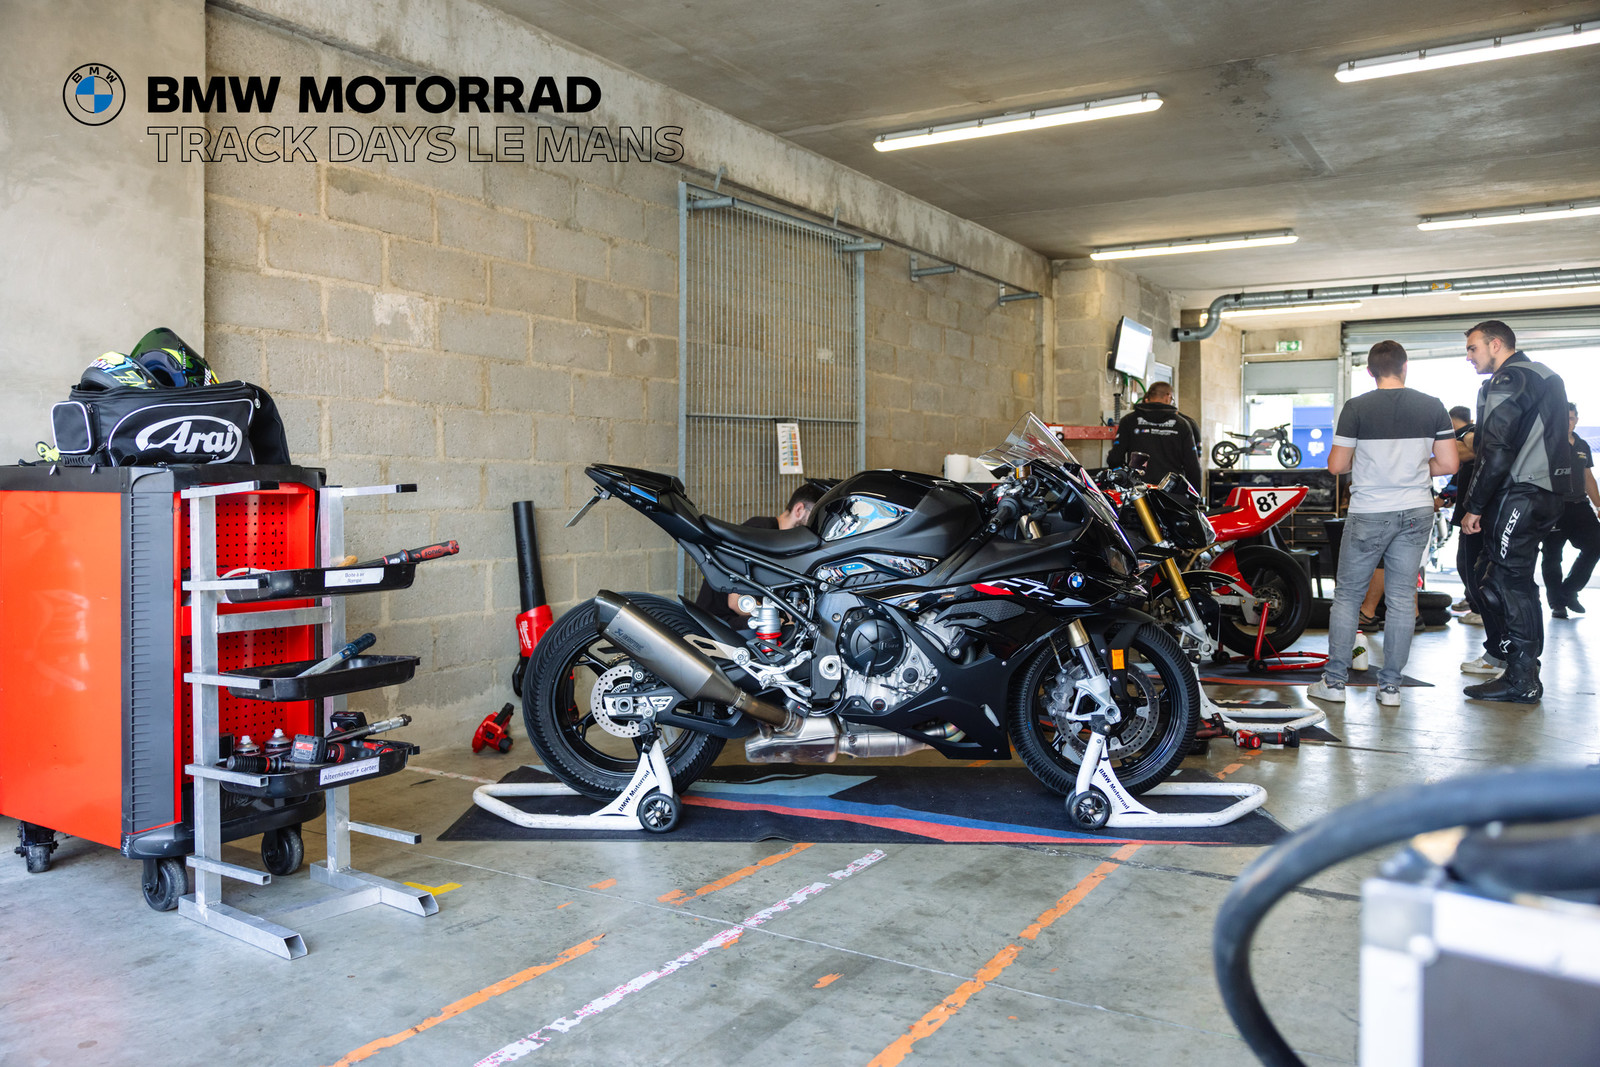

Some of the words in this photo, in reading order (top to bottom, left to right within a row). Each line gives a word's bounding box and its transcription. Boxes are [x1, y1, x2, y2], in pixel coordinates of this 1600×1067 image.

[144, 420, 237, 454] Arai
[1256, 491, 1279, 512] 87
[1500, 507, 1521, 559] DAINESE
[323, 770, 356, 781] Alternateur
[361, 764, 377, 773] carter
[618, 796, 631, 812] BMW
[629, 769, 650, 798] Motorrad
[1098, 768, 1111, 784] BMW
[1110, 783, 1130, 810] Motorrad
